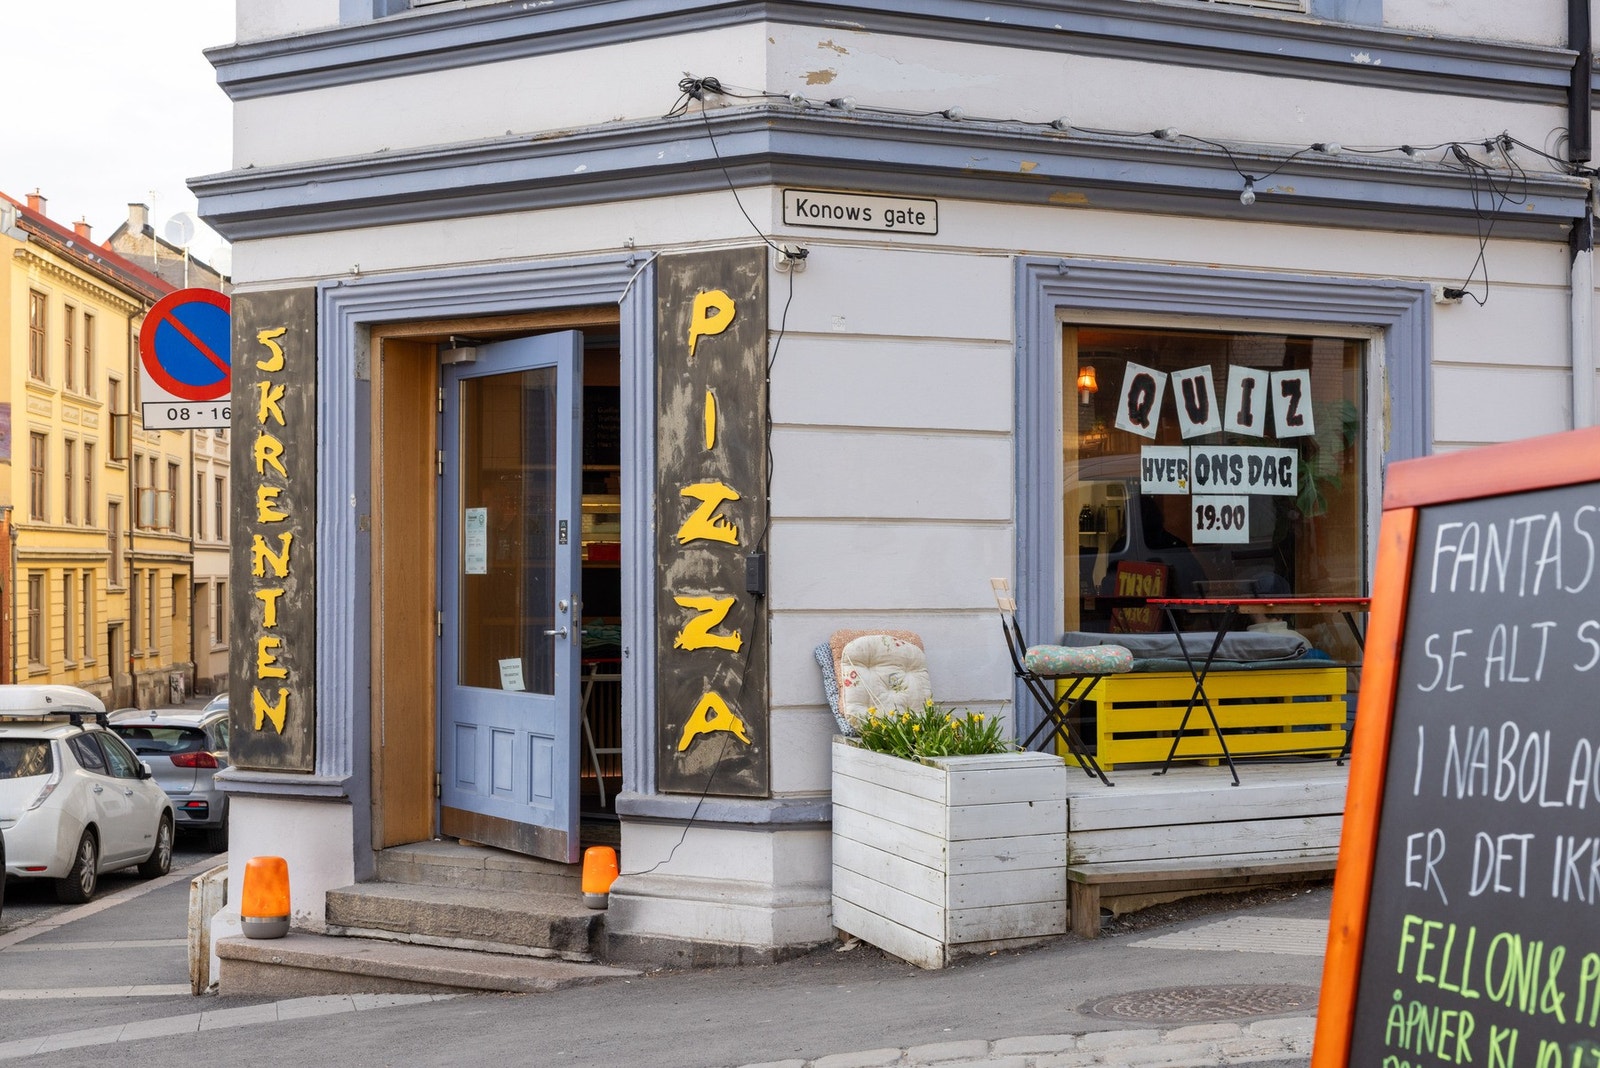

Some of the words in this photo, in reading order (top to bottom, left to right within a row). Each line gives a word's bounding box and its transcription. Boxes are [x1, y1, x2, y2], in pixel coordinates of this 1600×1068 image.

[796, 198, 872, 222] Konows
[884, 207, 926, 228] gate
[167, 407, 190, 421] 08
[211, 407, 230, 420] 16
[1127, 372, 1304, 429] QUIZ
[1142, 457, 1188, 482] HVER
[252, 326, 292, 736] SKRENTEN
[676, 289, 751, 752] PIZZA
[1195, 504, 1246, 531] 19:00
[1430, 504, 1600, 597] FANTAS
[1417, 628, 1474, 692] SE
[1484, 621, 1558, 689] ALT
[1413, 724, 1424, 797] I
[1405, 827, 1449, 906] ER
[1468, 831, 1536, 898] DET
[1384, 989, 1476, 1066] ÅPNER
